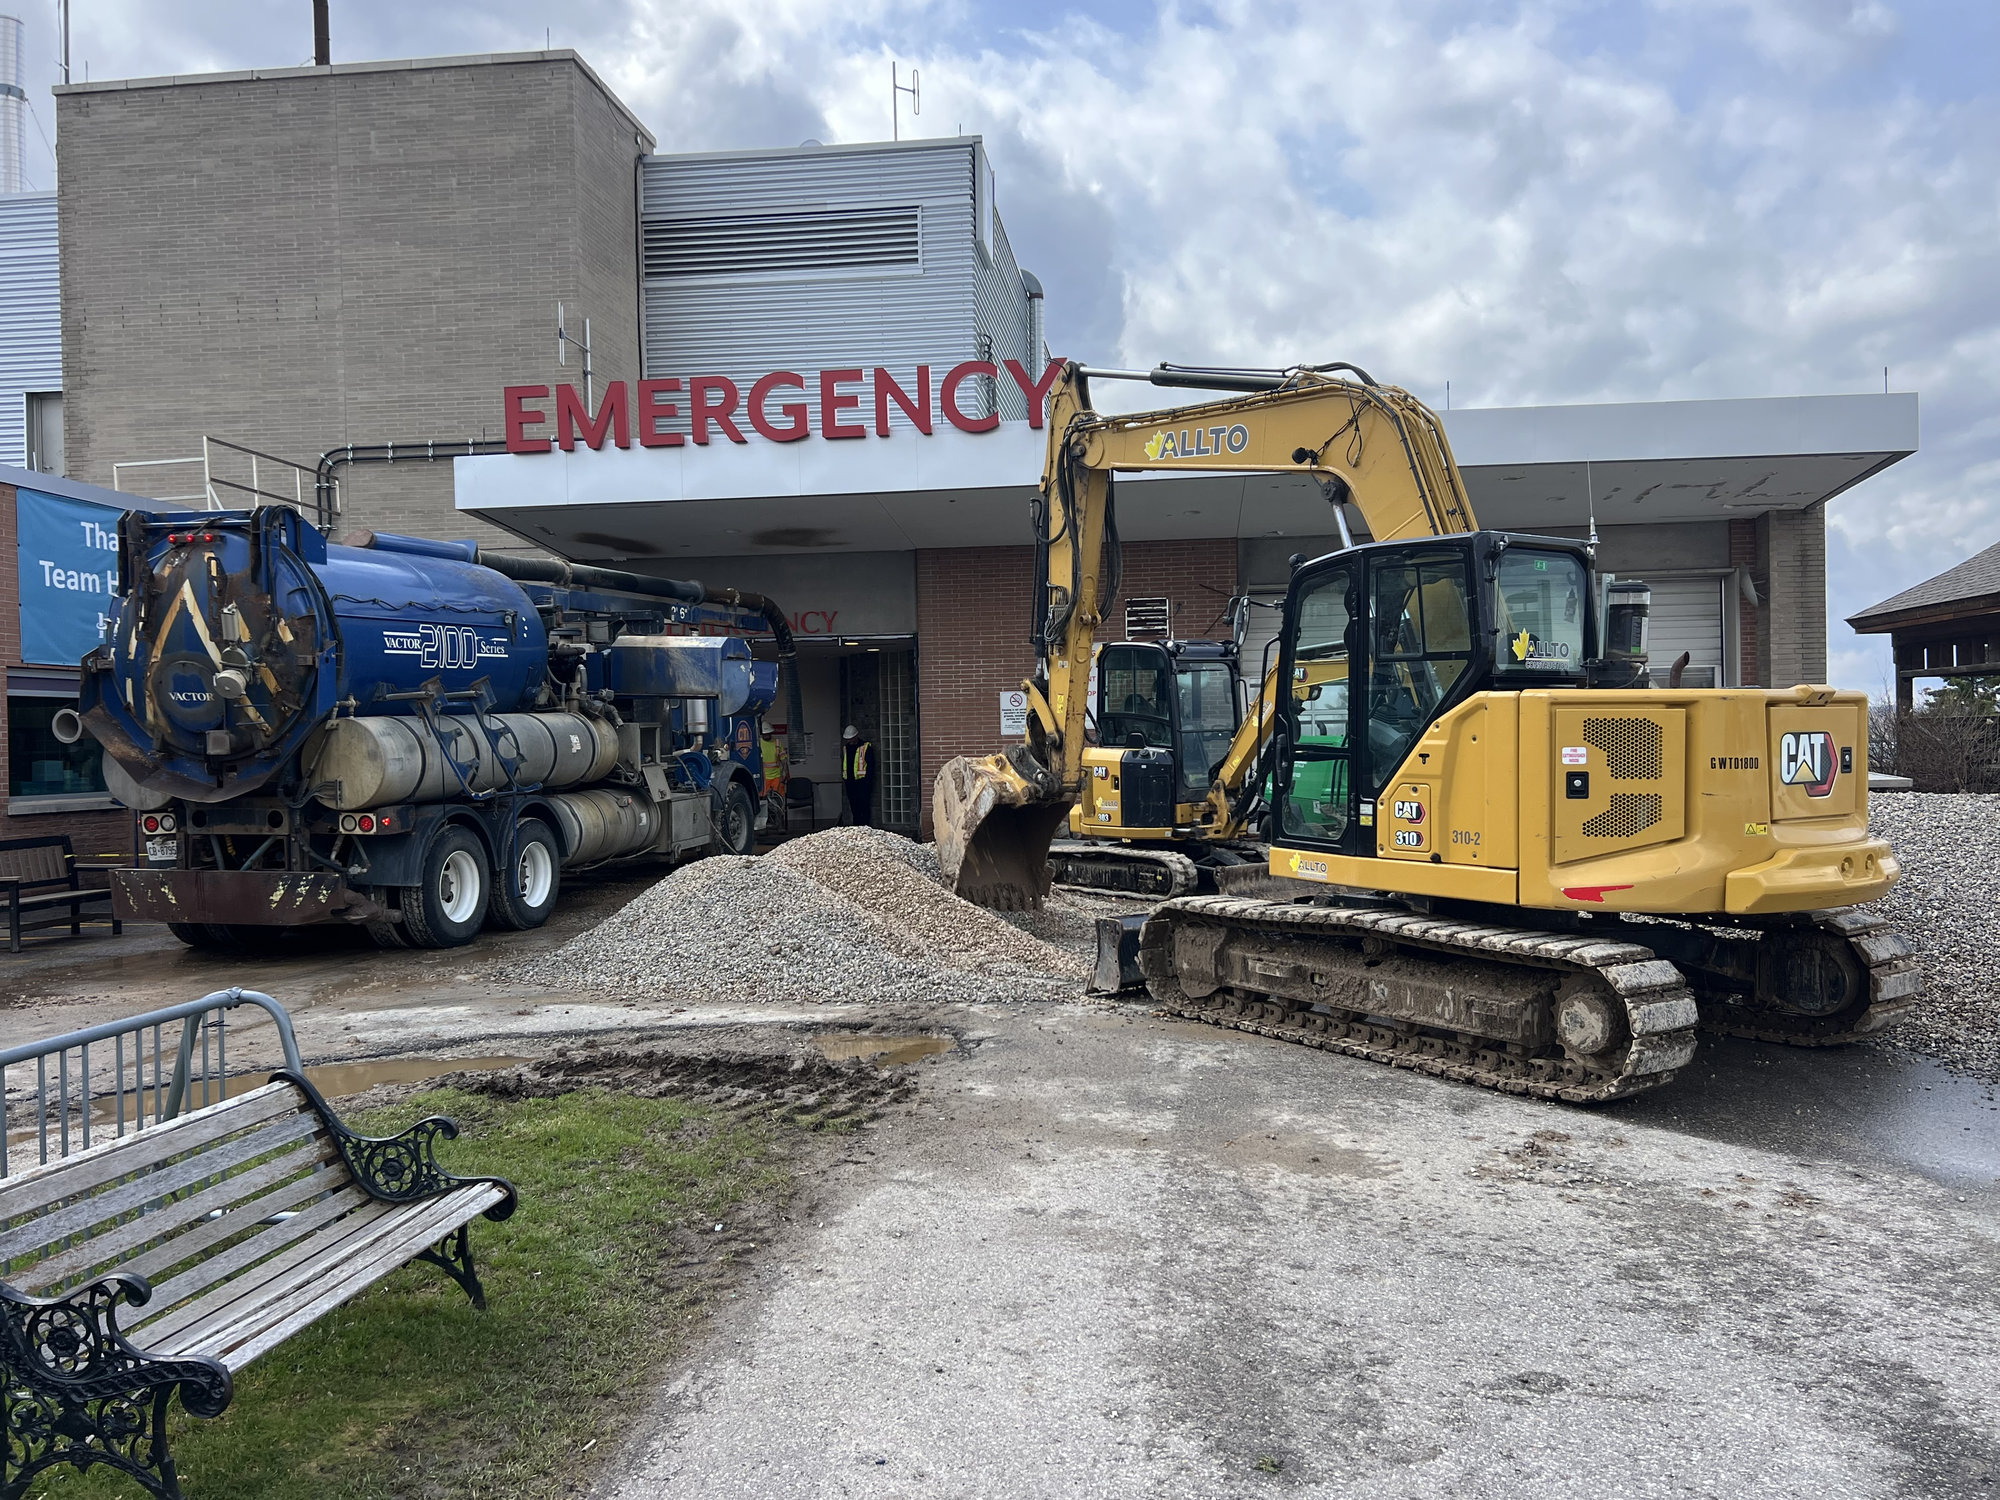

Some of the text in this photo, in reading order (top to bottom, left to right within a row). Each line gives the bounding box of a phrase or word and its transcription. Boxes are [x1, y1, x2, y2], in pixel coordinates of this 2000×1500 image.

[503, 358, 1067, 454] EMERGENCY
[1158, 424, 1249, 460] ALLTO
[80, 521, 119, 551] Tha
[39, 560, 101, 593] Team
[384, 624, 505, 669] VACTOR 2100 Series
[1526, 640, 1569, 659] ALLTO
[168, 692, 215, 702] VACTOR
[1780, 732, 1825, 784] CAT
[1094, 766, 1107, 777] CAT
[1395, 801, 1418, 819] CAT
[1396, 831, 1417, 846] 310
[1452, 830, 1480, 845] 310-2
[1298, 860, 1327, 873] ALLTO
